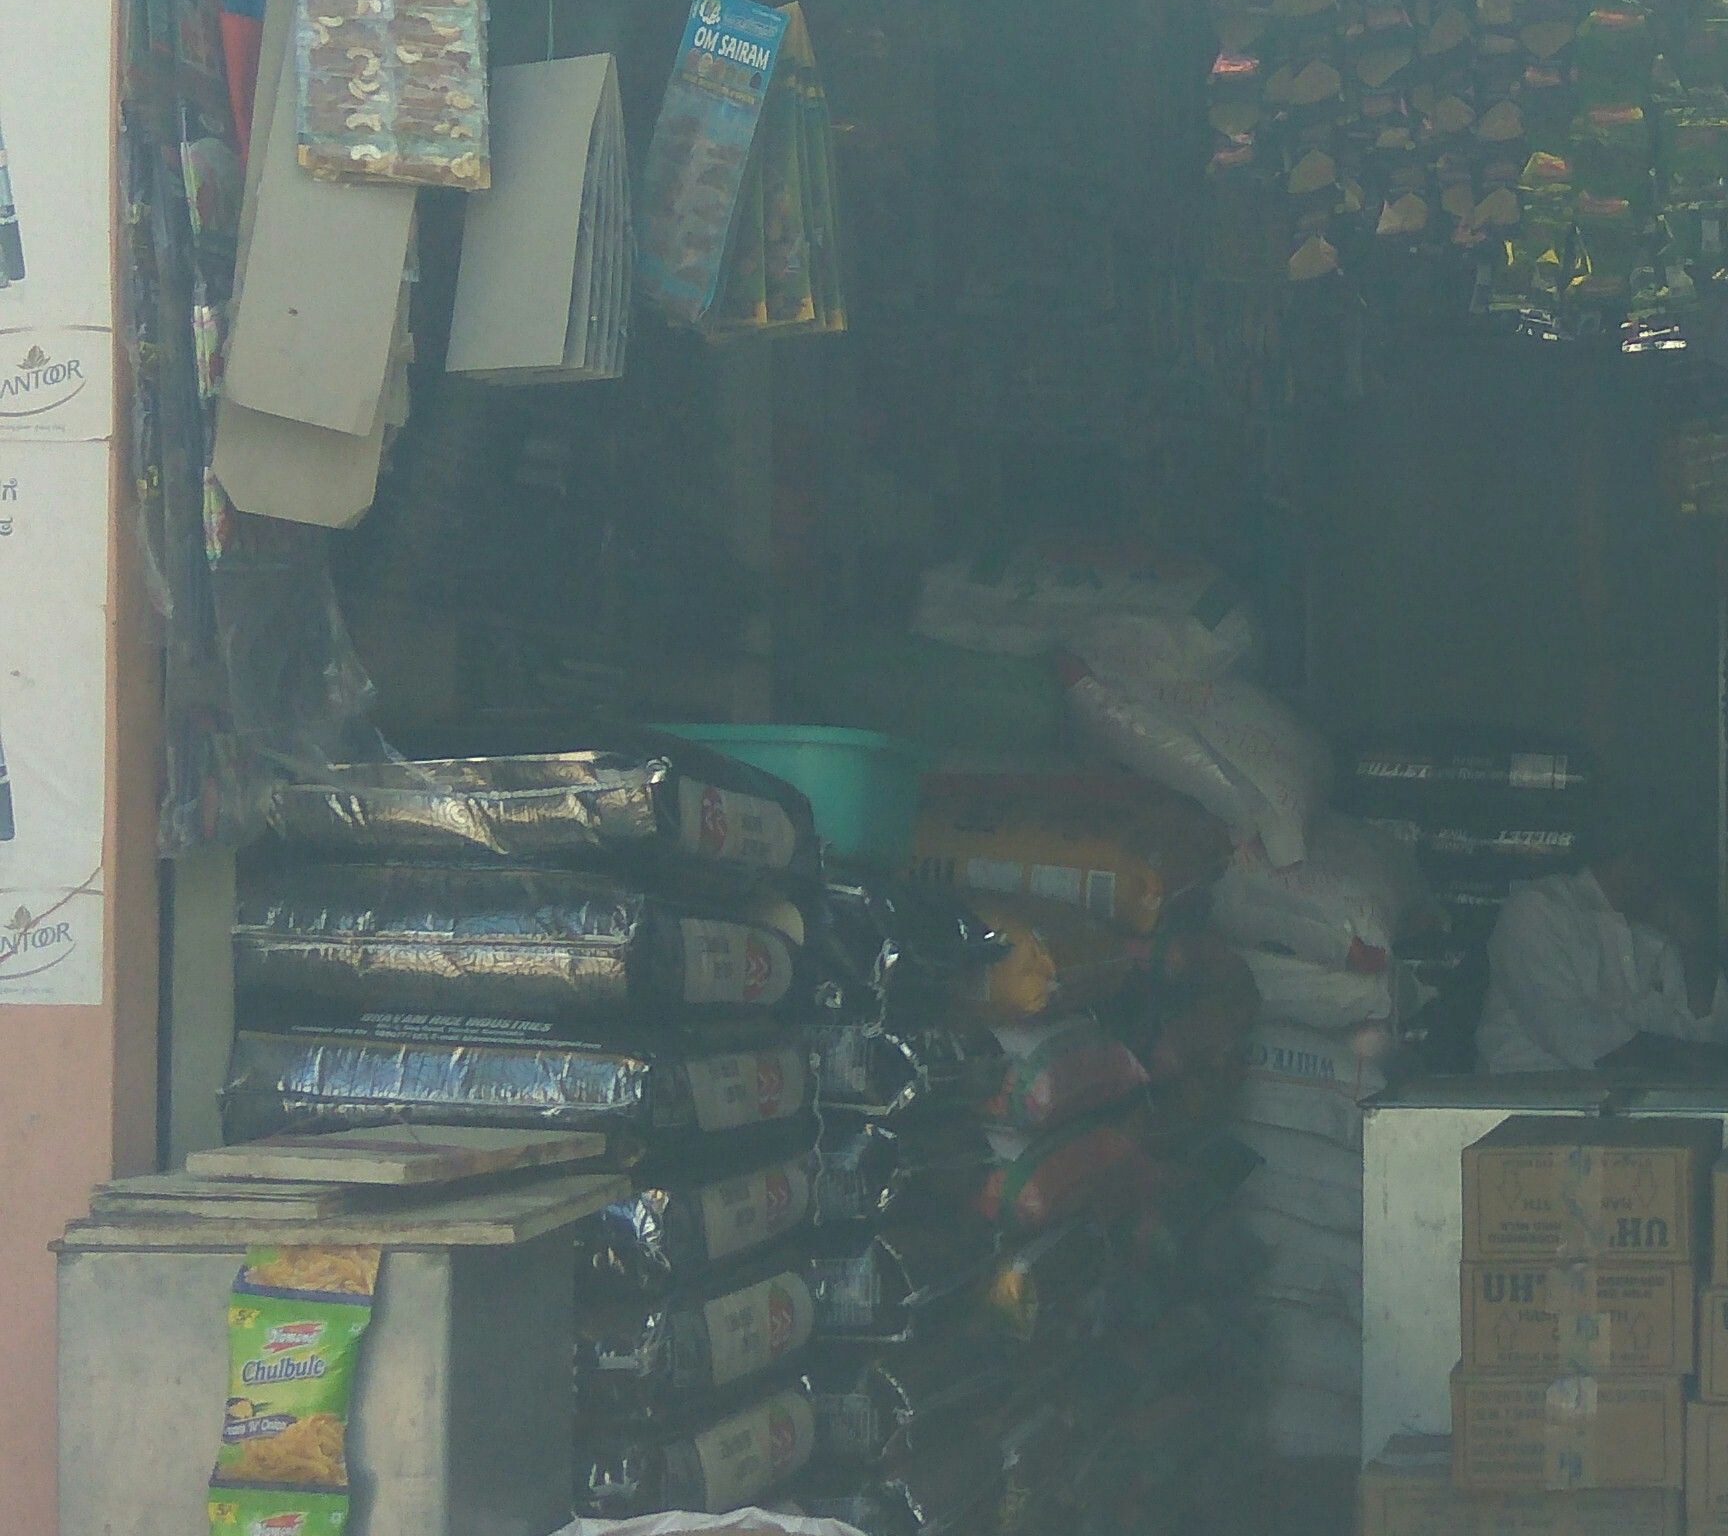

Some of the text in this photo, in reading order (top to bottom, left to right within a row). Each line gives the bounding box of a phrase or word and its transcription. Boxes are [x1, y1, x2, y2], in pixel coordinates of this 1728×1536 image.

[693, 25, 771, 72] OM SAIRAM
[0, 359, 84, 399] ANTOOR
[0, 922, 73, 953] NTOOR
[1608, 1218, 1671, 1248] UH
[242, 1354, 327, 1385] Chulbule
